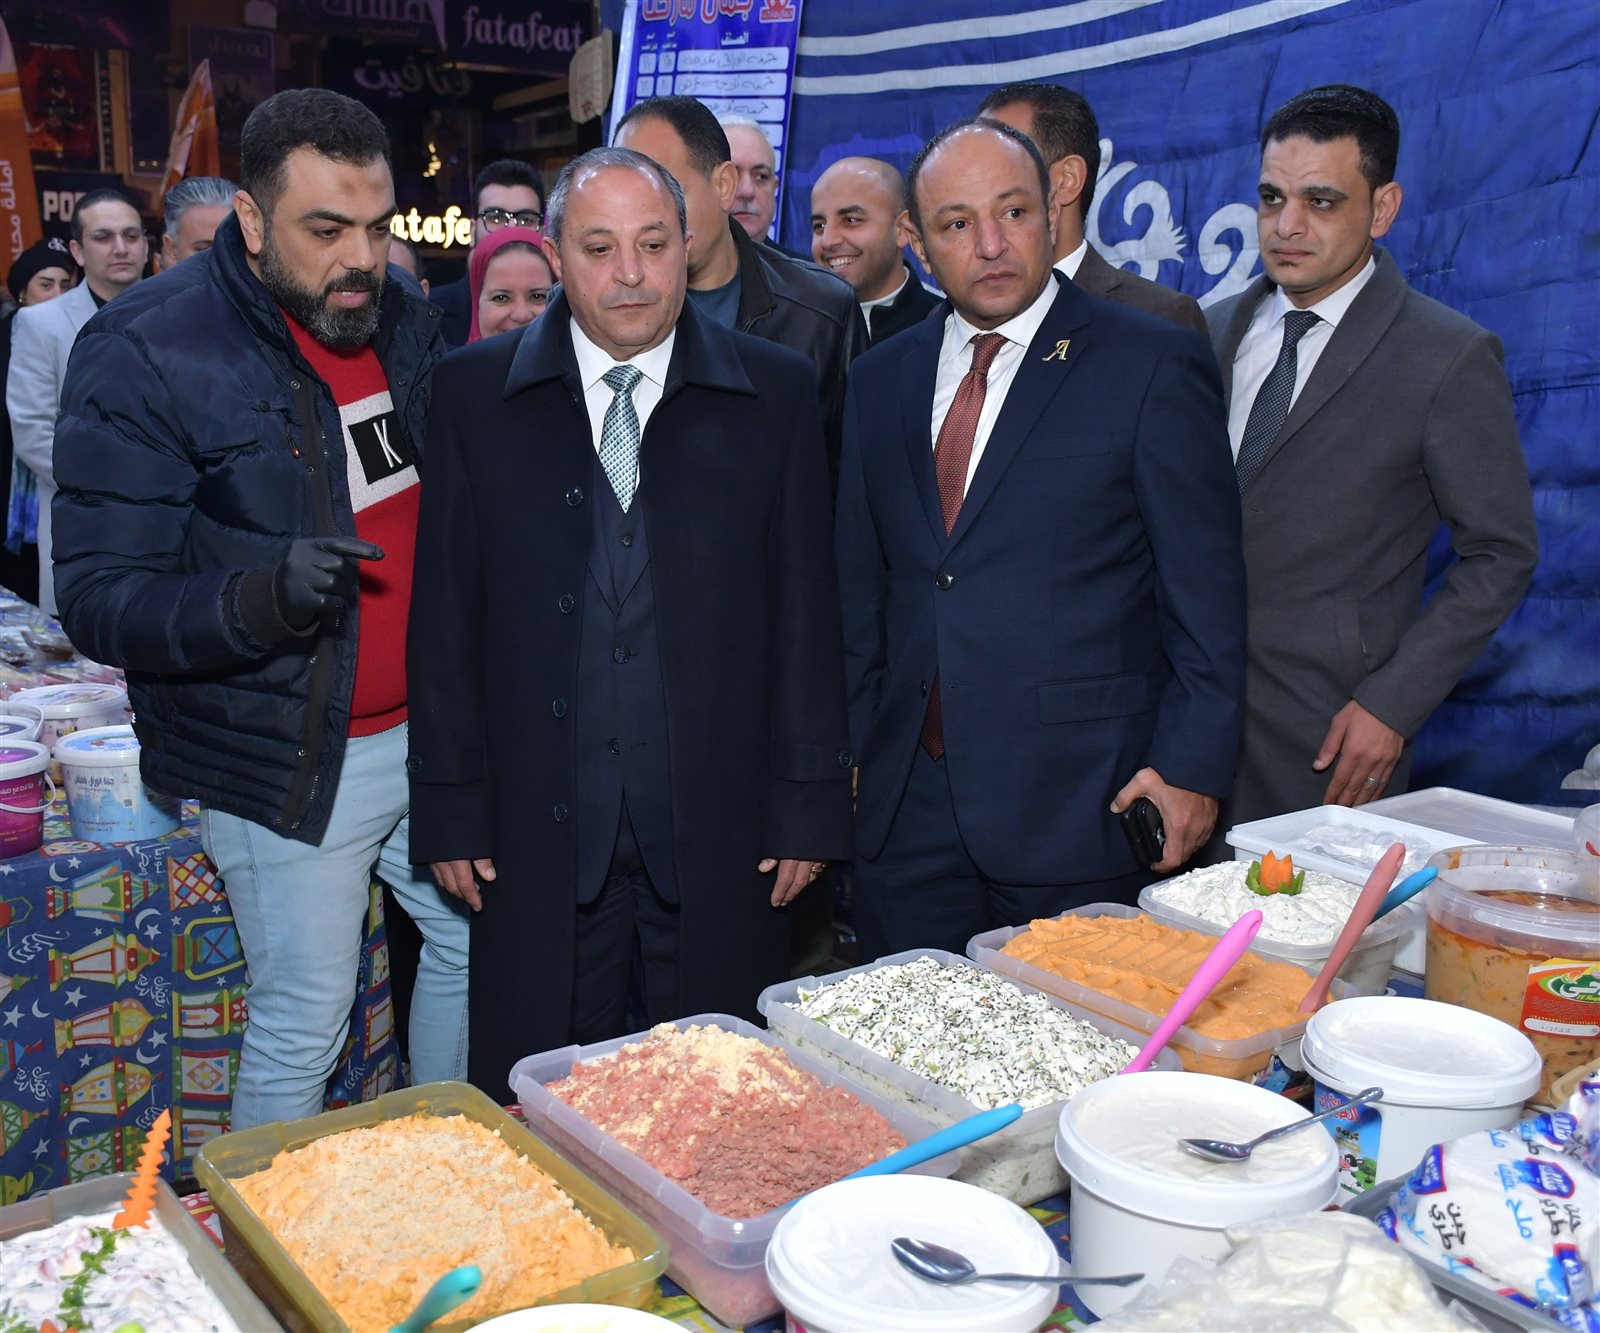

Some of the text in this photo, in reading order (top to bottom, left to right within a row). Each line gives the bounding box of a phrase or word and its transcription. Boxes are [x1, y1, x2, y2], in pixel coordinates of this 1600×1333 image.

[462, 4, 584, 54] fatafeat
[721, 31, 750, 46] الصنف
[373, 419, 403, 469] K
[1428, 1204, 1452, 1250] طري
[1447, 1202, 1470, 1246] جبن
[1506, 1198, 1534, 1240] ملح
[1539, 1199, 1561, 1237] طري
